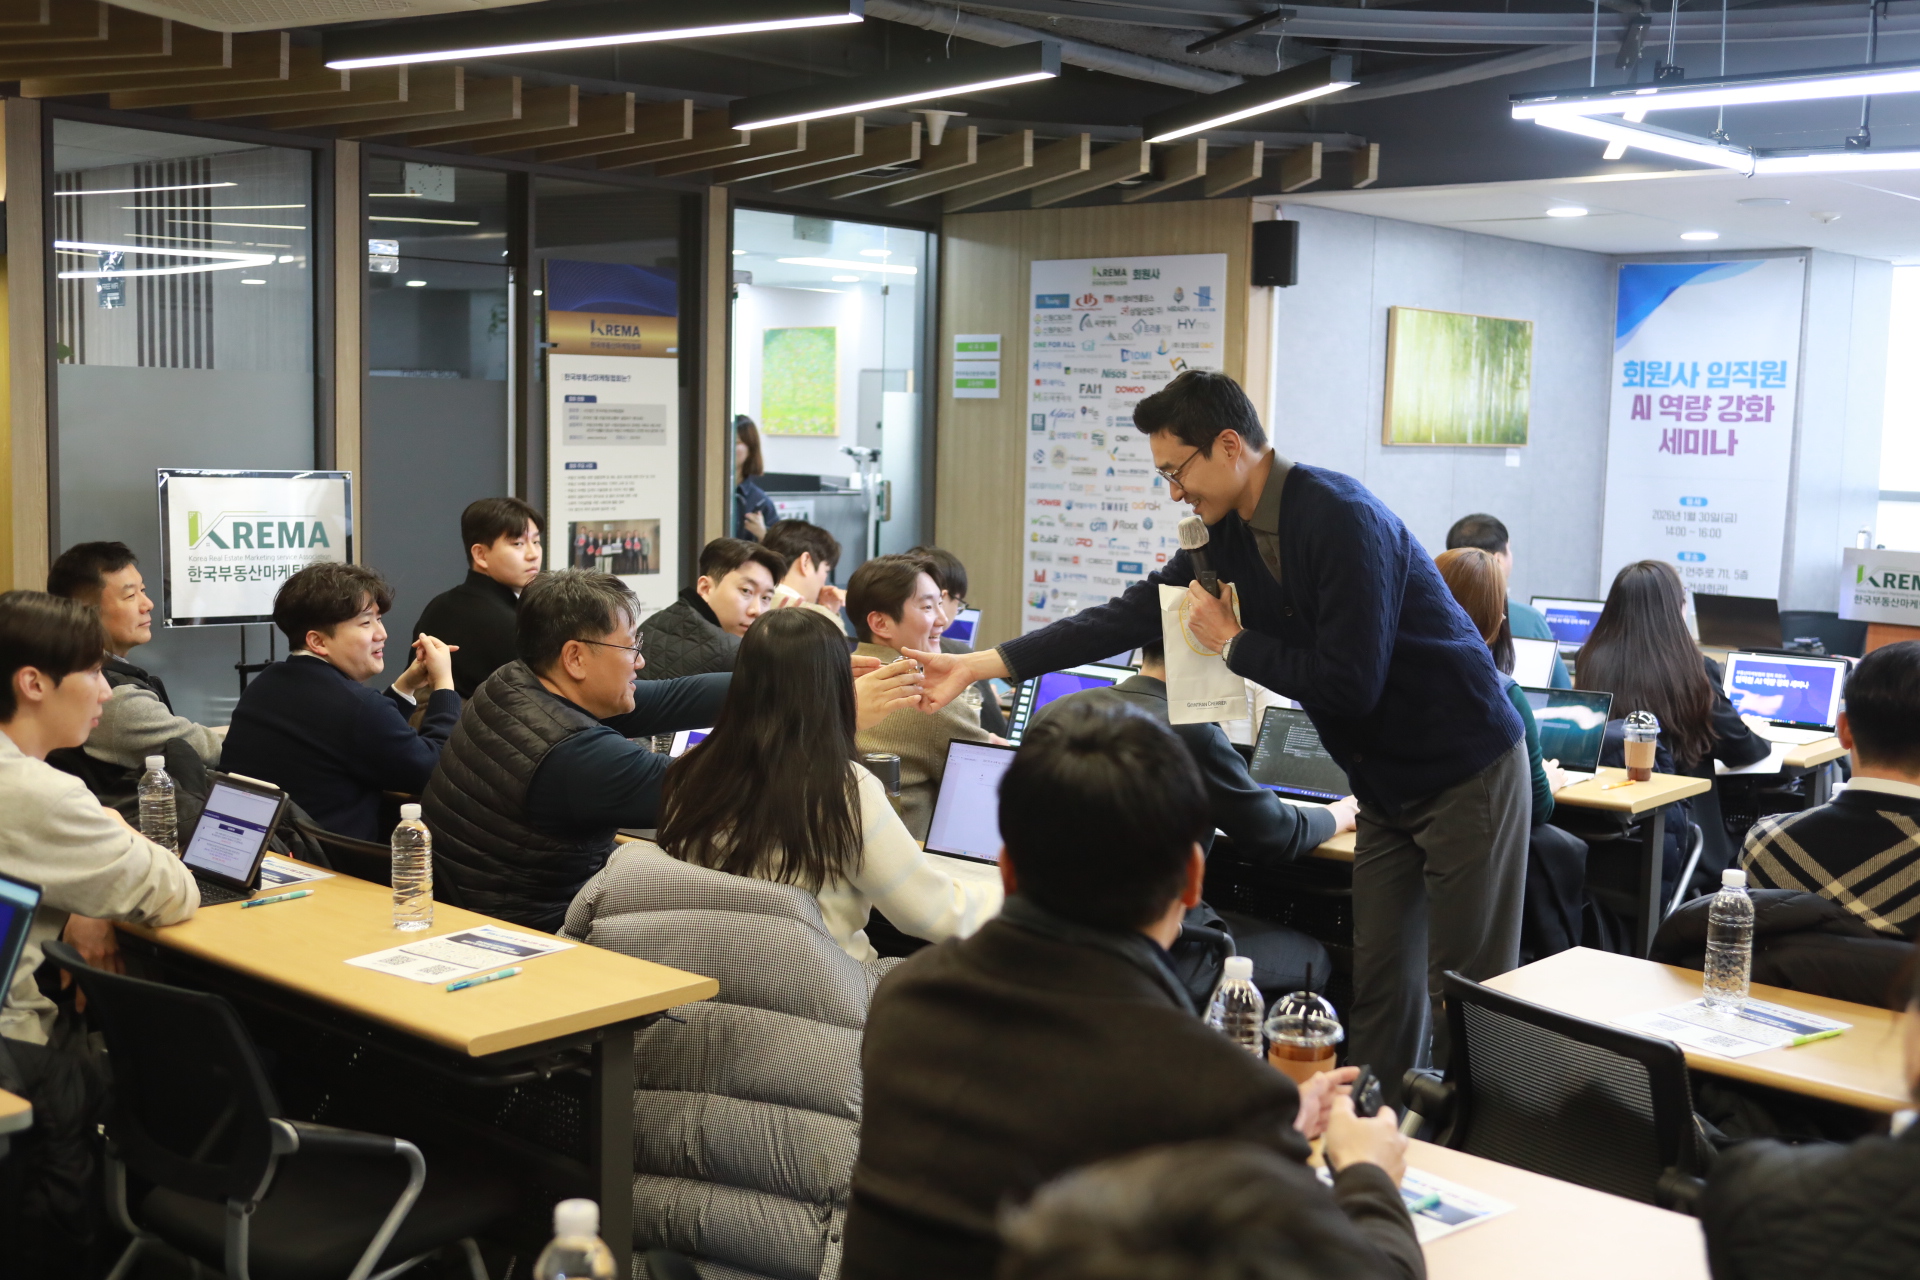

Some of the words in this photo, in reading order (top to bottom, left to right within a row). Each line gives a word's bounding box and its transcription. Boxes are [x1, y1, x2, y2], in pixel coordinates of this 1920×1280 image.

[1092, 266, 1128, 277] KREMA
[1132, 268, 1161, 280] 회원사
[590, 319, 641, 337] KREMA
[1622, 360, 1700, 388] 회원사
[1707, 360, 1787, 389] 임직원
[1630, 394, 1651, 420] AI
[1659, 394, 1712, 422] 역량
[1717, 394, 1775, 423] 강화
[1658, 428, 1739, 456] 세미나
[1652, 509, 1681, 521] 2026년
[1683, 511, 1696, 522] 1월
[1698, 512, 1738, 524] 30일(금)
[188, 511, 331, 550] KREMA
[1665, 525, 1686, 537] 14:00
[1698, 527, 1722, 539] 16:00
[209, 554, 223, 562] Real
[224, 554, 243, 562] Estate
[244, 554, 275, 563] Marketing
[298, 553, 332, 561] Association
[1685, 566, 1714, 578] 언주로
[1734, 569, 1749, 581] 5층
